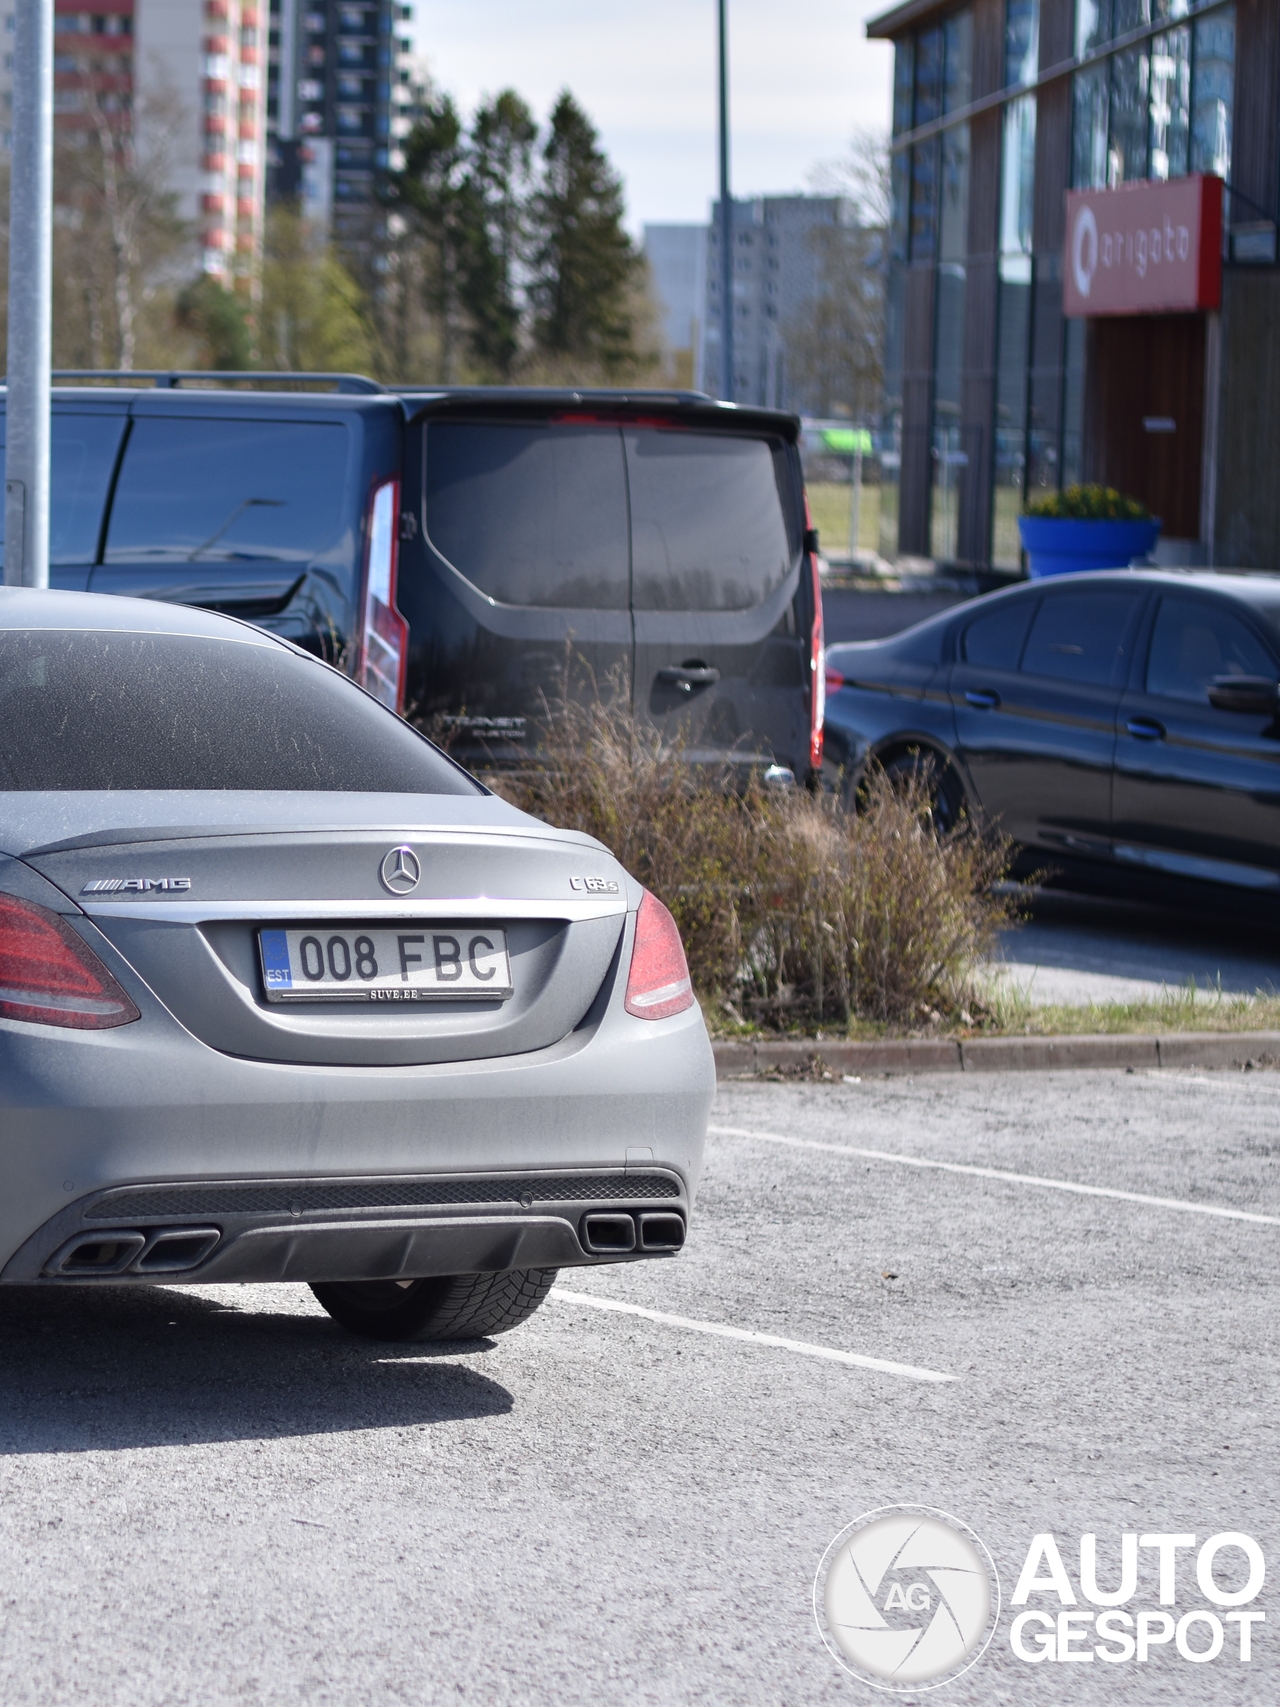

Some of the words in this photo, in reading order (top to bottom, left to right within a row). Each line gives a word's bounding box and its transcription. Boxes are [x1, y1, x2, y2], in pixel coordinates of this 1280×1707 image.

[443, 715, 527, 727] TRANSIT
[118, 878, 191, 890] AMG
[299, 935, 379, 982] 008
[397, 935, 497, 982] FBC
[267, 969, 290, 982] EST
[370, 989, 418, 999] SUVE.EE
